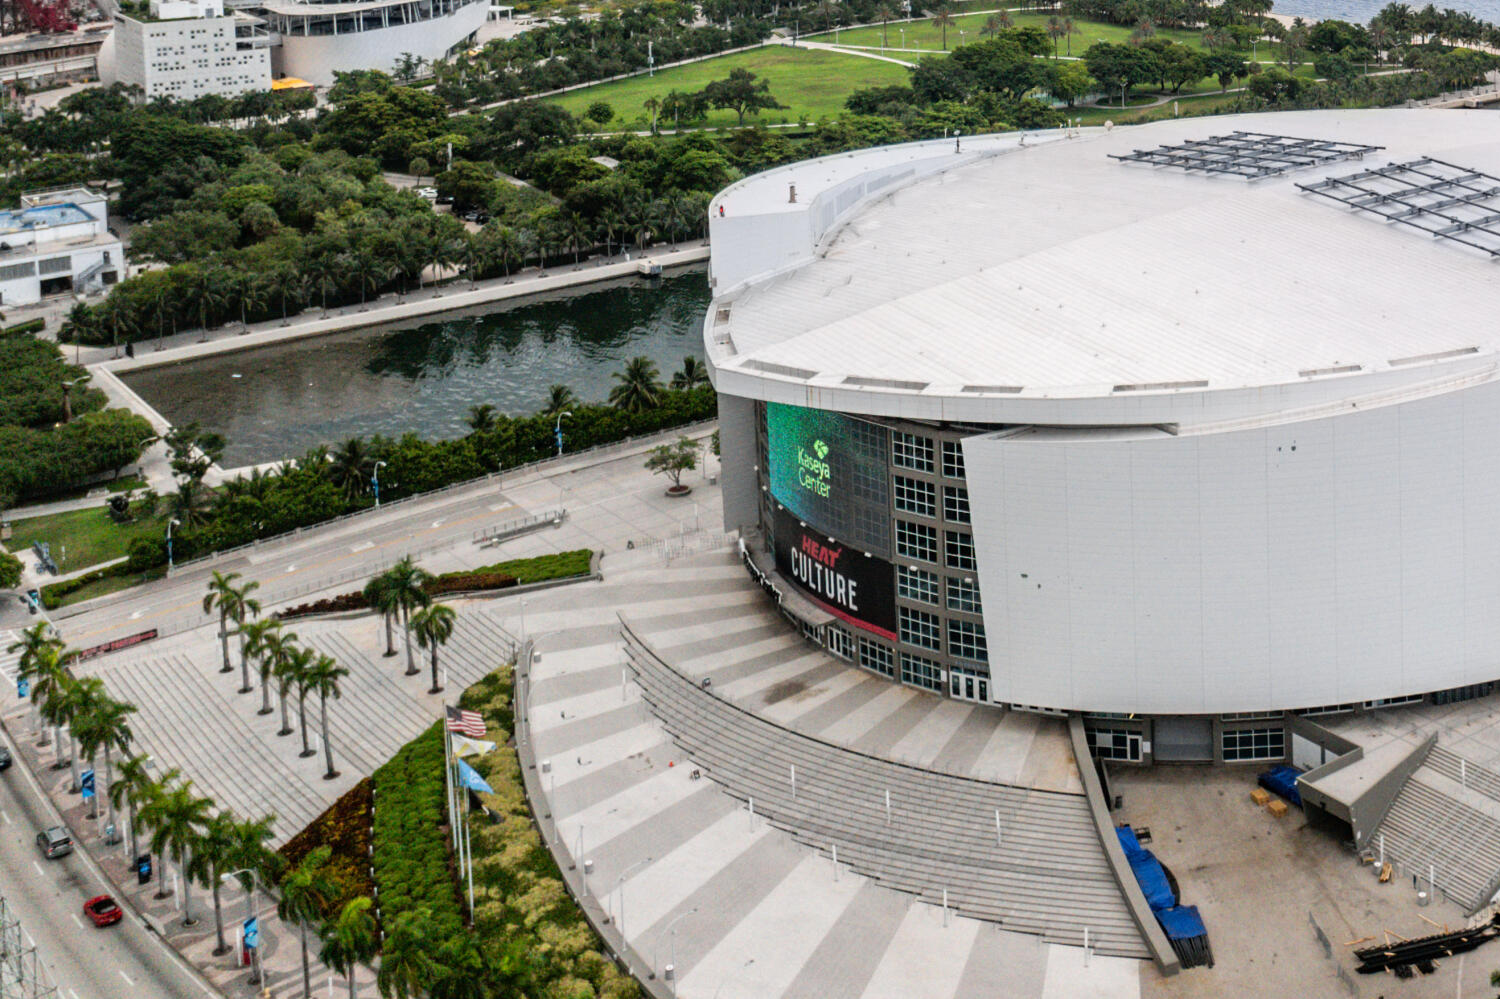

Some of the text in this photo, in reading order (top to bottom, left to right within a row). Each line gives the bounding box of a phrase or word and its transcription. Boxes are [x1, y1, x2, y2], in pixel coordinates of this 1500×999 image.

[797, 445, 830, 480] Kaseya
[799, 466, 831, 498] Center
[802, 534, 842, 568] HEAT
[791, 546, 858, 611] CULTURE
